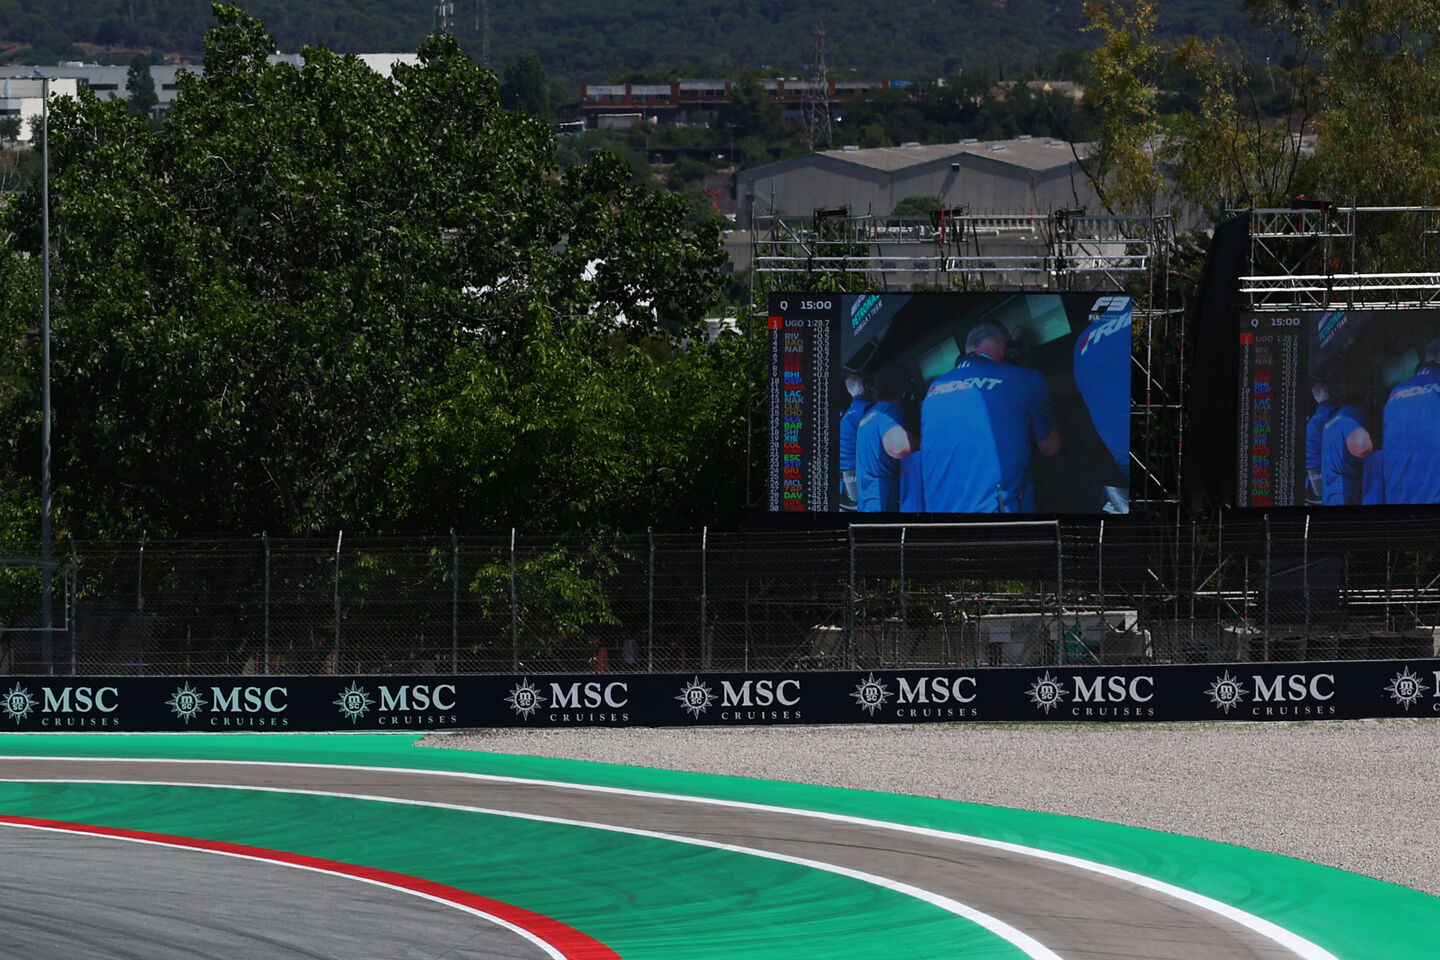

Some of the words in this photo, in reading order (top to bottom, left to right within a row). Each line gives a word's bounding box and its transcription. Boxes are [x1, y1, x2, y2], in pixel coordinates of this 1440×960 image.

[780, 301, 788, 311] Q
[801, 301, 832, 310] 15:00
[896, 676, 977, 704] MSC
[1071, 675, 1154, 703] MSC
[1252, 673, 1335, 702] MSC
[377, 684, 456, 712] MSC
[549, 681, 628, 709] MSC
[720, 679, 801, 707] MSC
[41, 686, 119, 713] MSC
[210, 686, 288, 713] MSC
[896, 708, 977, 717] CRUISES
[1071, 707, 1154, 716] CRUISES
[1252, 705, 1335, 715] CRUISES
[377, 716, 456, 725] CRUISES
[549, 713, 628, 722] CRUISES
[720, 711, 801, 720] CRUISES
[41, 717, 119, 726] CRUISES
[210, 717, 288, 726] CRUISES
